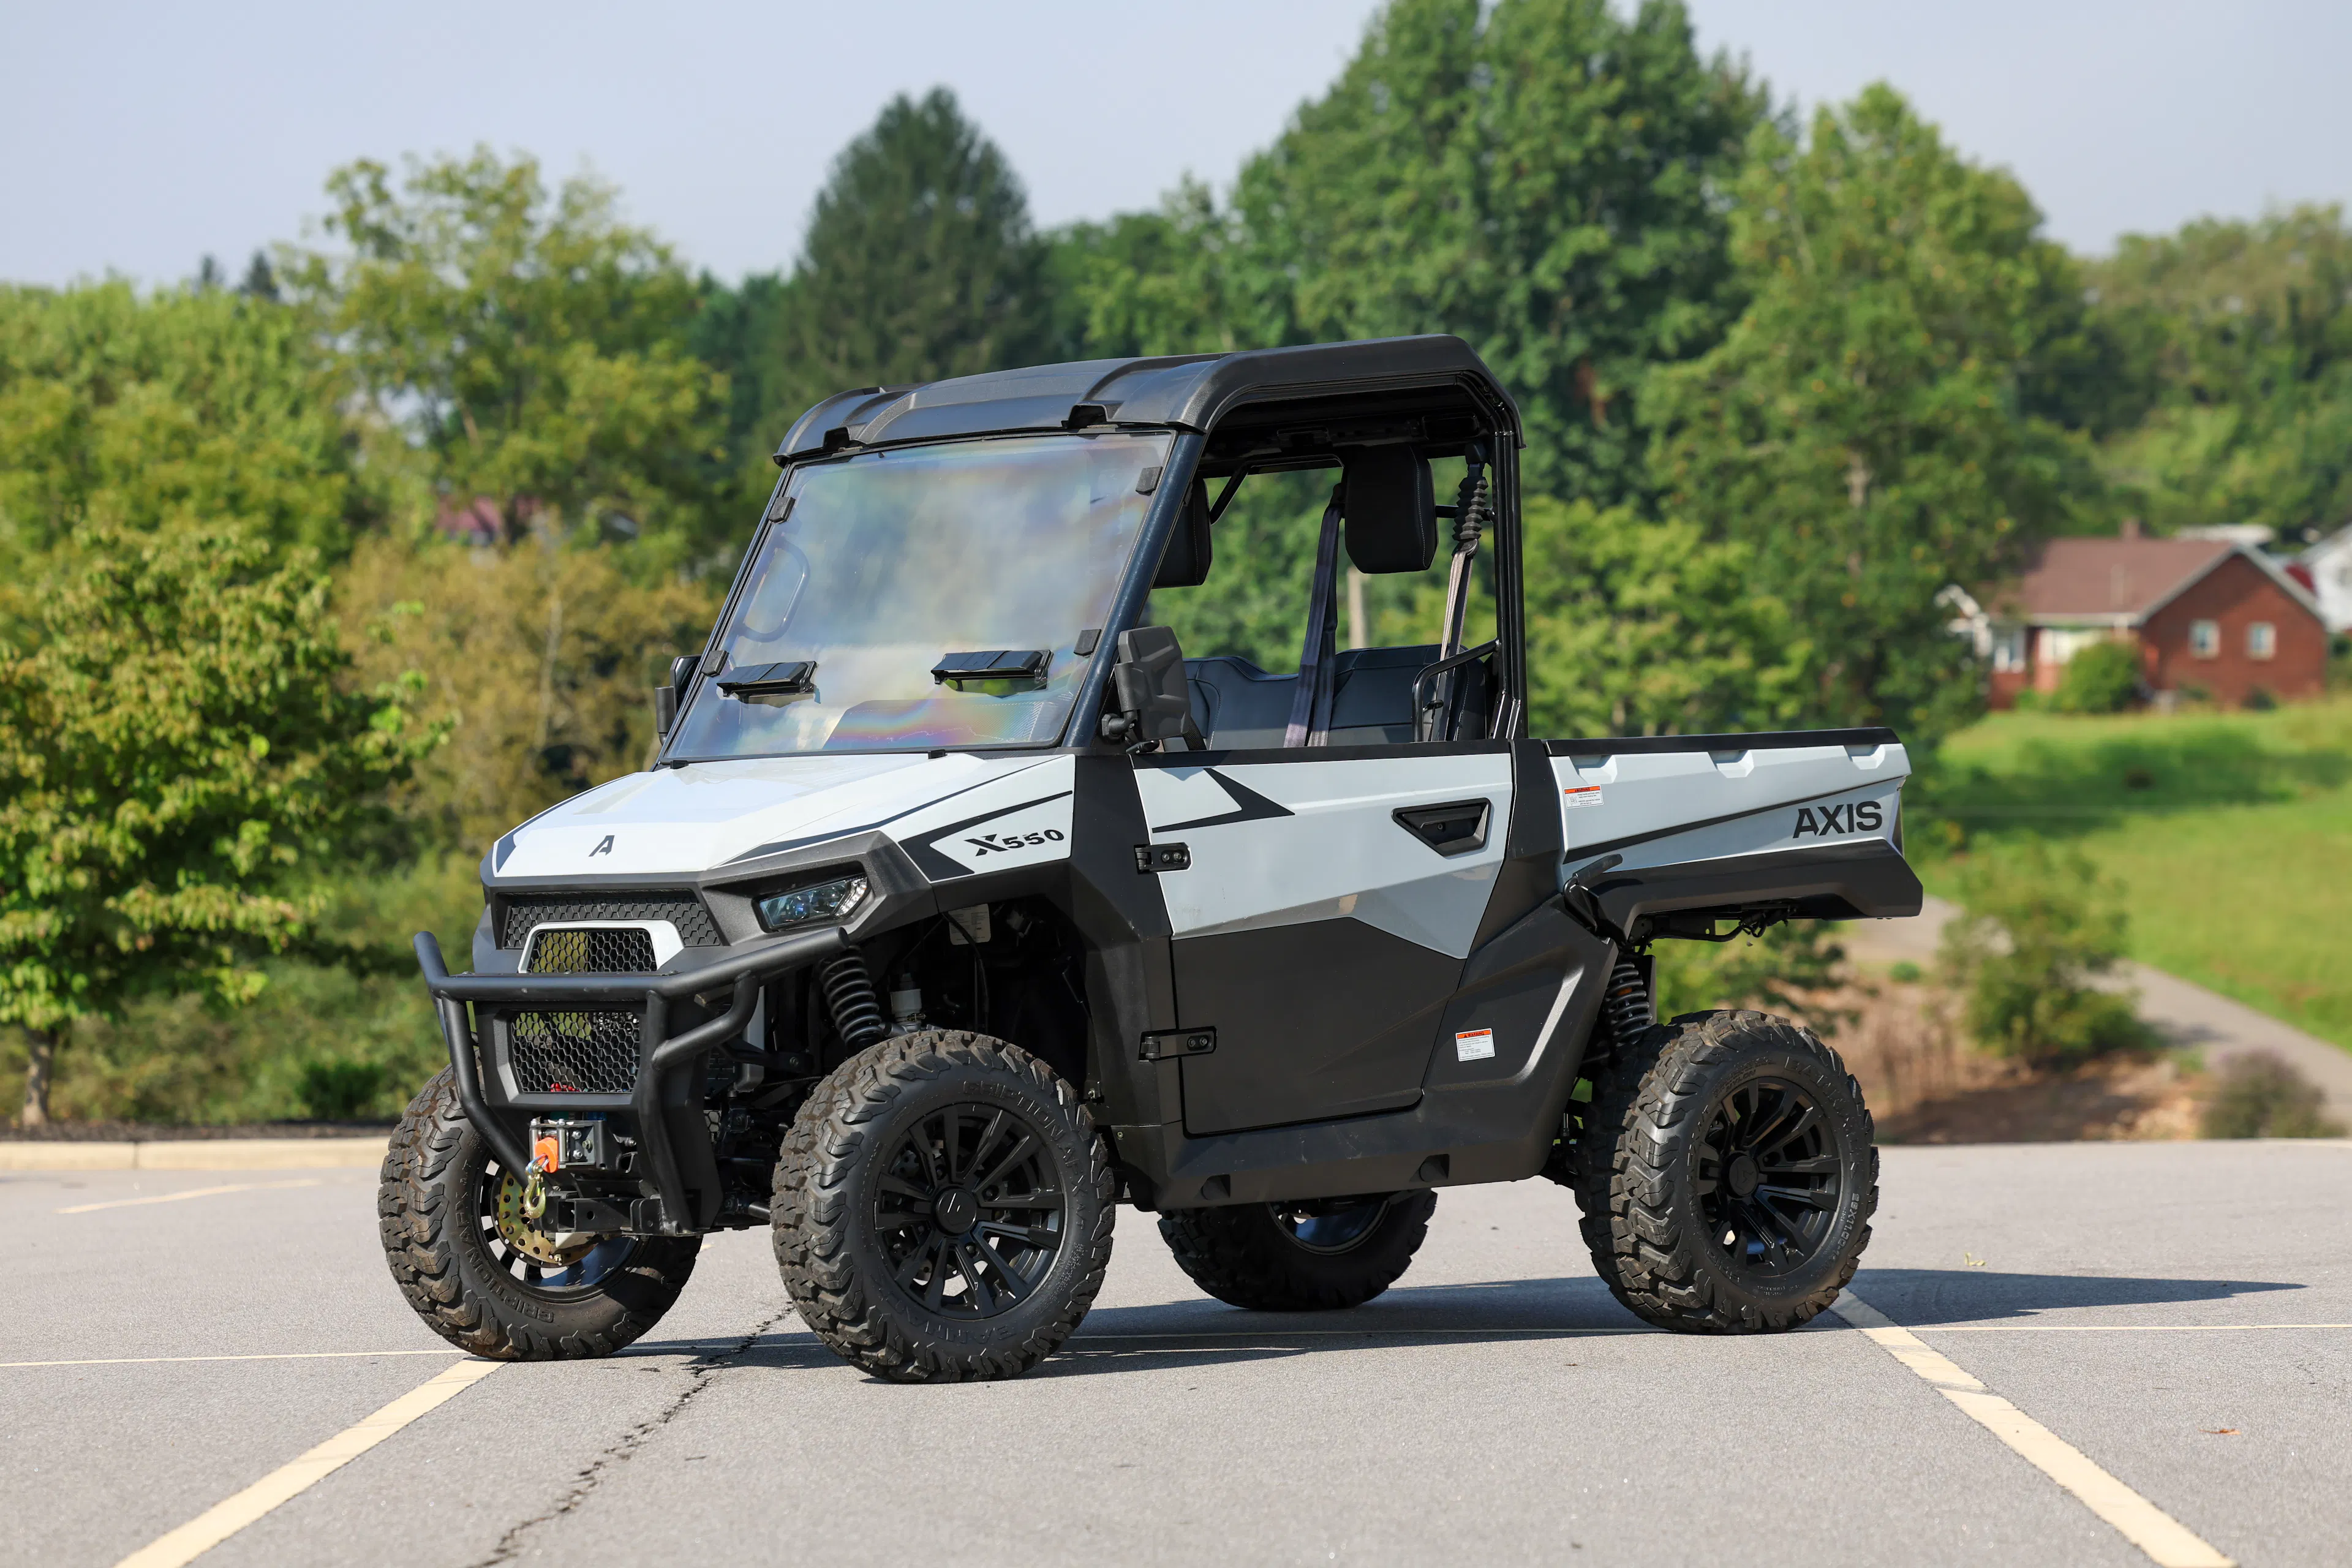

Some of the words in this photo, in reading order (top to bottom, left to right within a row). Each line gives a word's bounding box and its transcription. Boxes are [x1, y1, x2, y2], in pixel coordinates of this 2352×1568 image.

[1792, 801, 1883, 839] AXIS
[963, 829, 1065, 857] X550
[465, 1246, 554, 1324] GRIPTION
